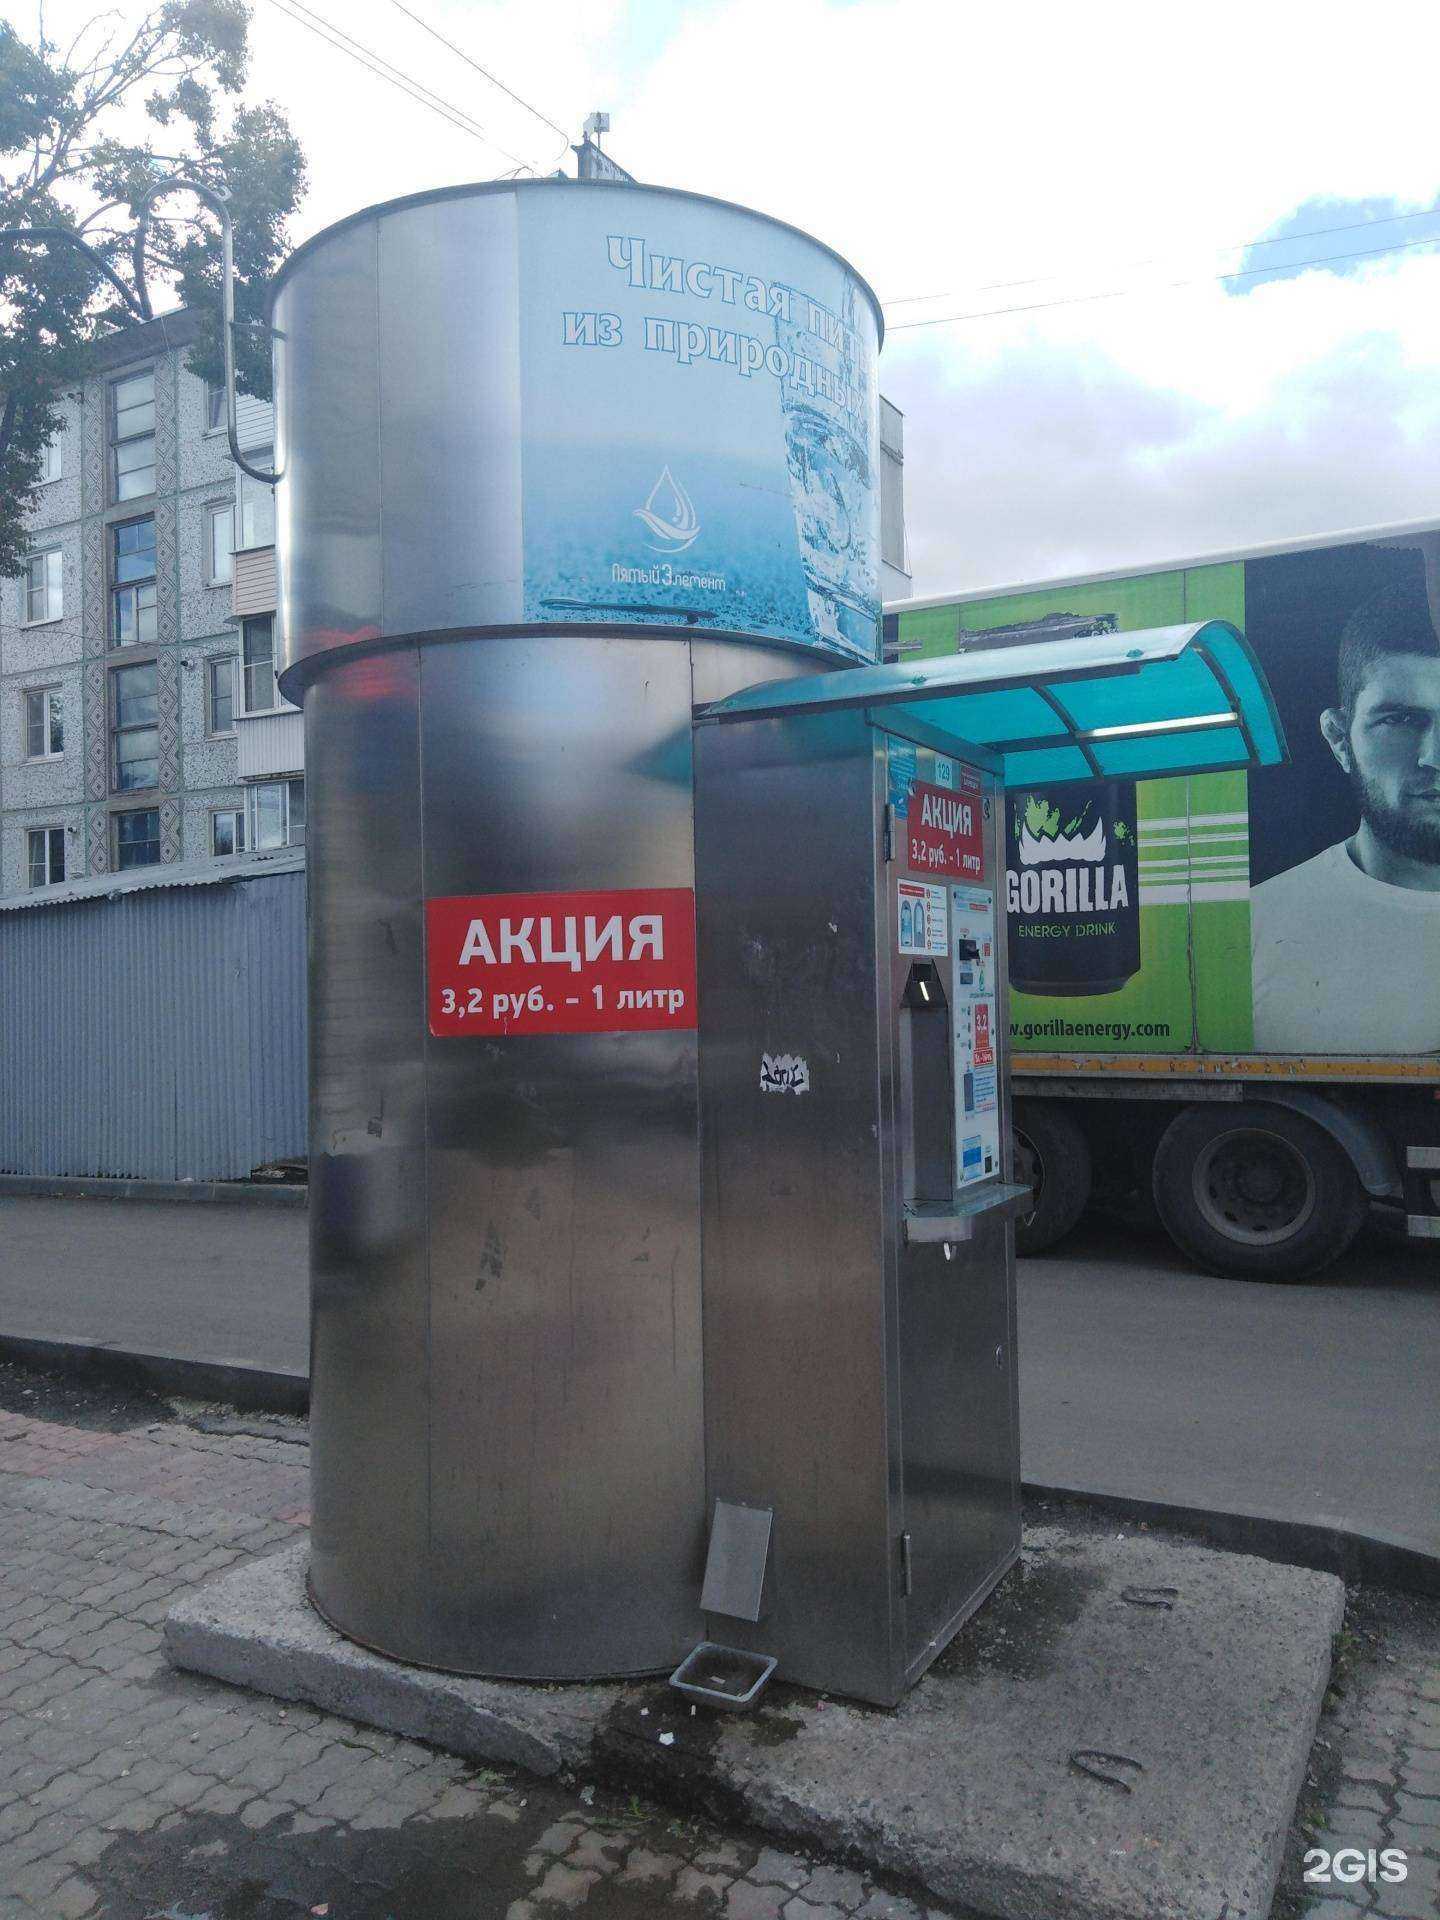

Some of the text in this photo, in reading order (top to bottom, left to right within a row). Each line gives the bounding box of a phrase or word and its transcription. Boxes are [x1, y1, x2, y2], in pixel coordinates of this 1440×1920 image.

[606, 235, 792, 323] Чистая
[563, 312, 623, 347] из
[611, 562, 660, 585] Пятый
[937, 759, 951, 782] 129
[921, 793, 973, 839] АКЦИЯ
[912, 838, 927, 864] 3,2
[929, 843, 947, 869] руб.
[955, 848, 960, 868] 1
[962, 854, 981, 875] литр
[1006, 864, 1129, 914] GORILLA
[458, 914, 664, 972] АКЦИЯ
[1018, 921, 1118, 938] ENERGY DRINK
[441, 987, 483, 1018] 3,2
[492, 985, 554, 1020] руб.
[591, 984, 604, 1010] 1
[616, 986, 685, 1015] литр
